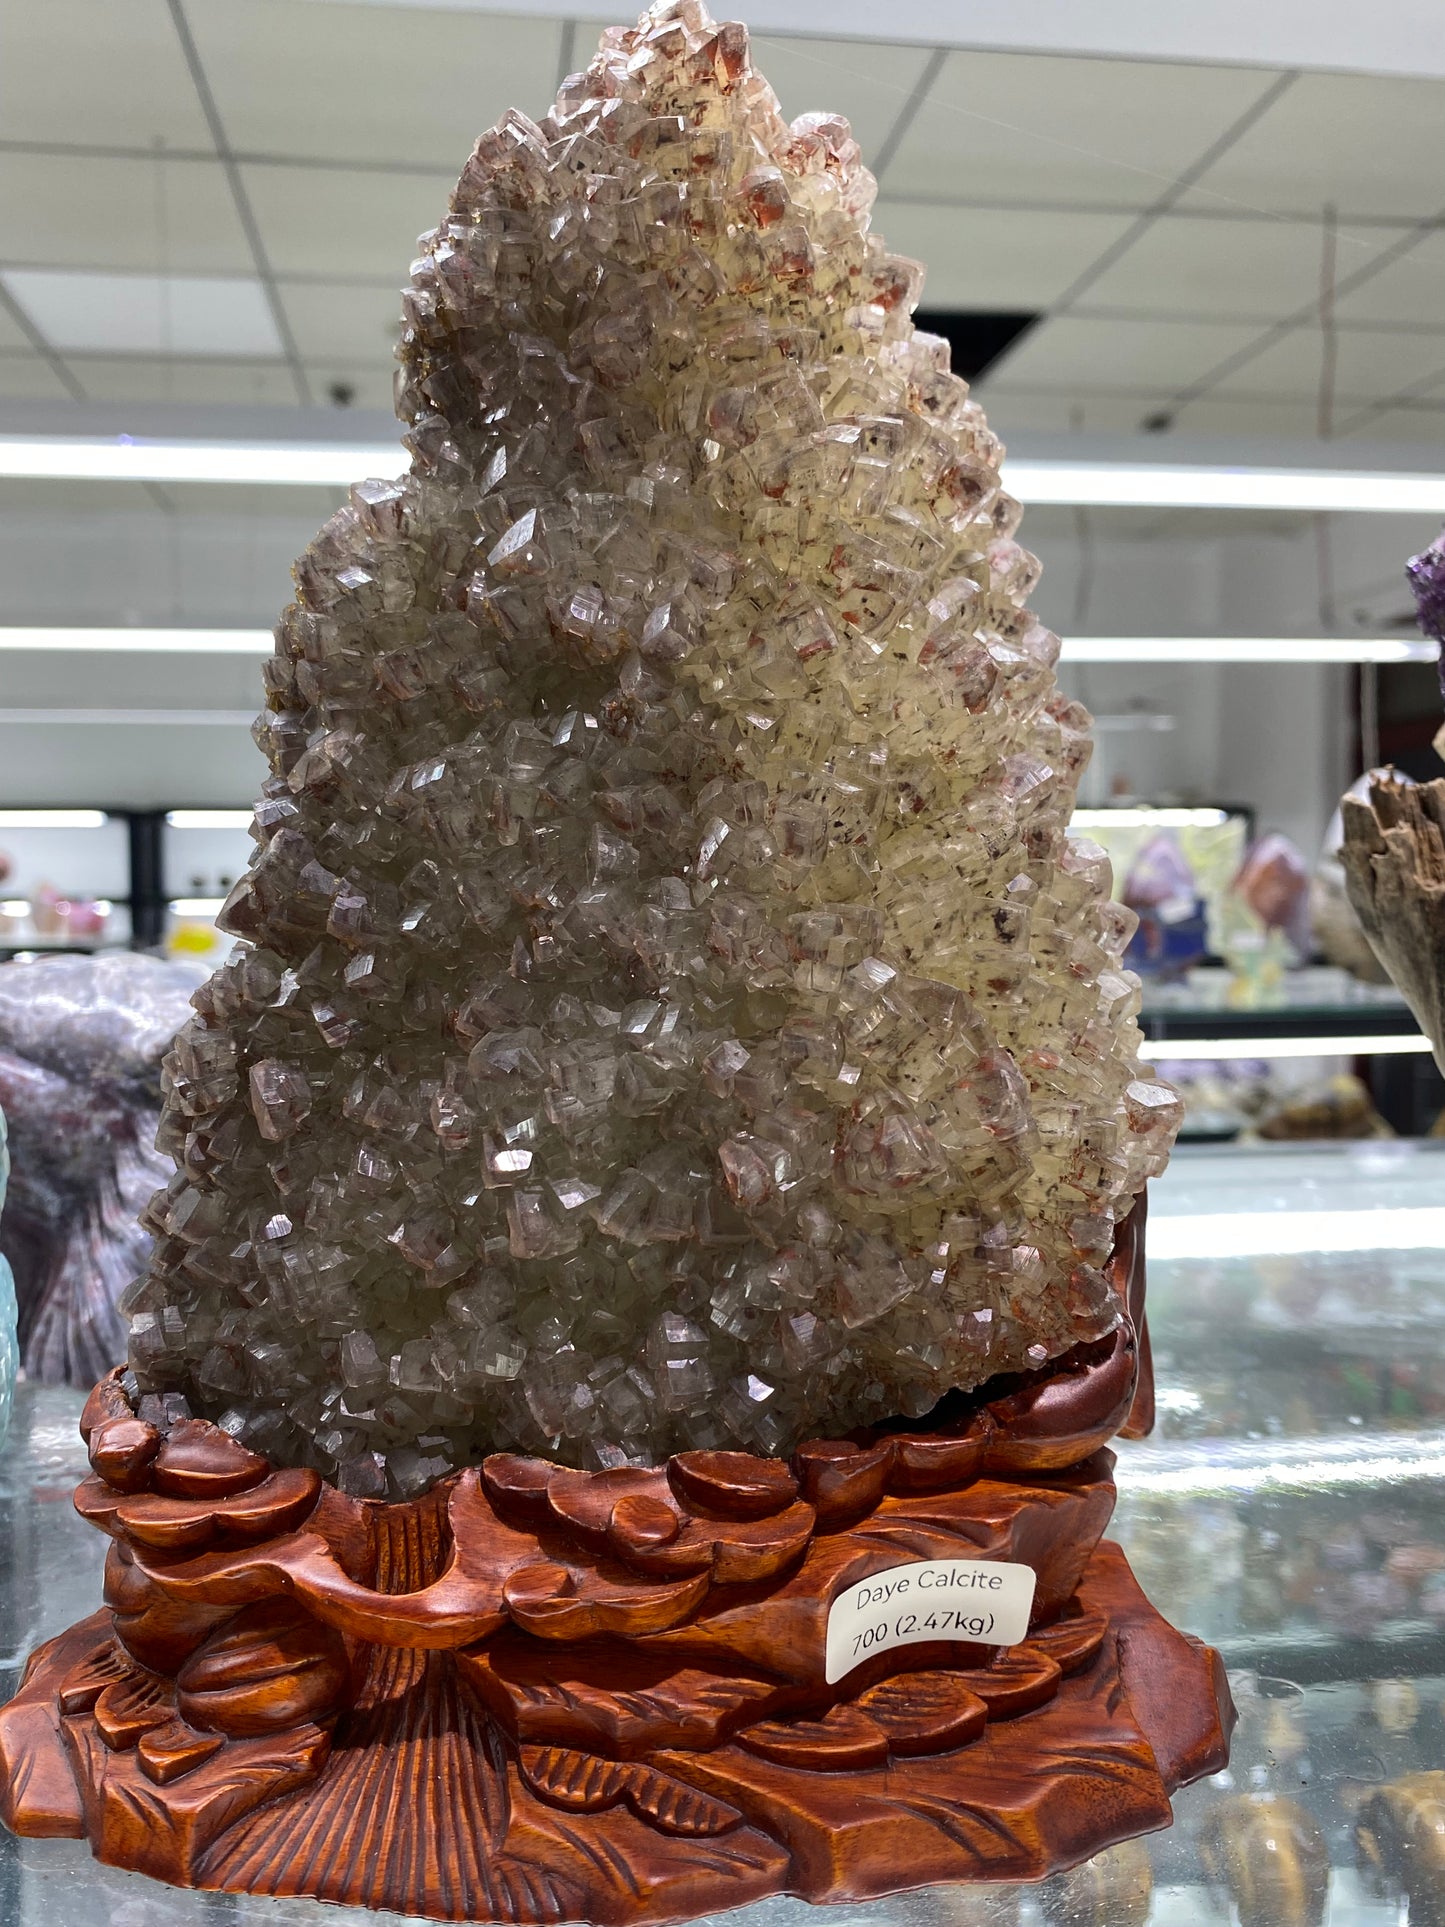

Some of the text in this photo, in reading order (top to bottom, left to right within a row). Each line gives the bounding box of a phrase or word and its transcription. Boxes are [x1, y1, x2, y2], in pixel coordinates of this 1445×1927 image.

[856, 1568, 1003, 1611] Daye Calcite
[852, 1611, 995, 1656] 700 (2.47kg)
